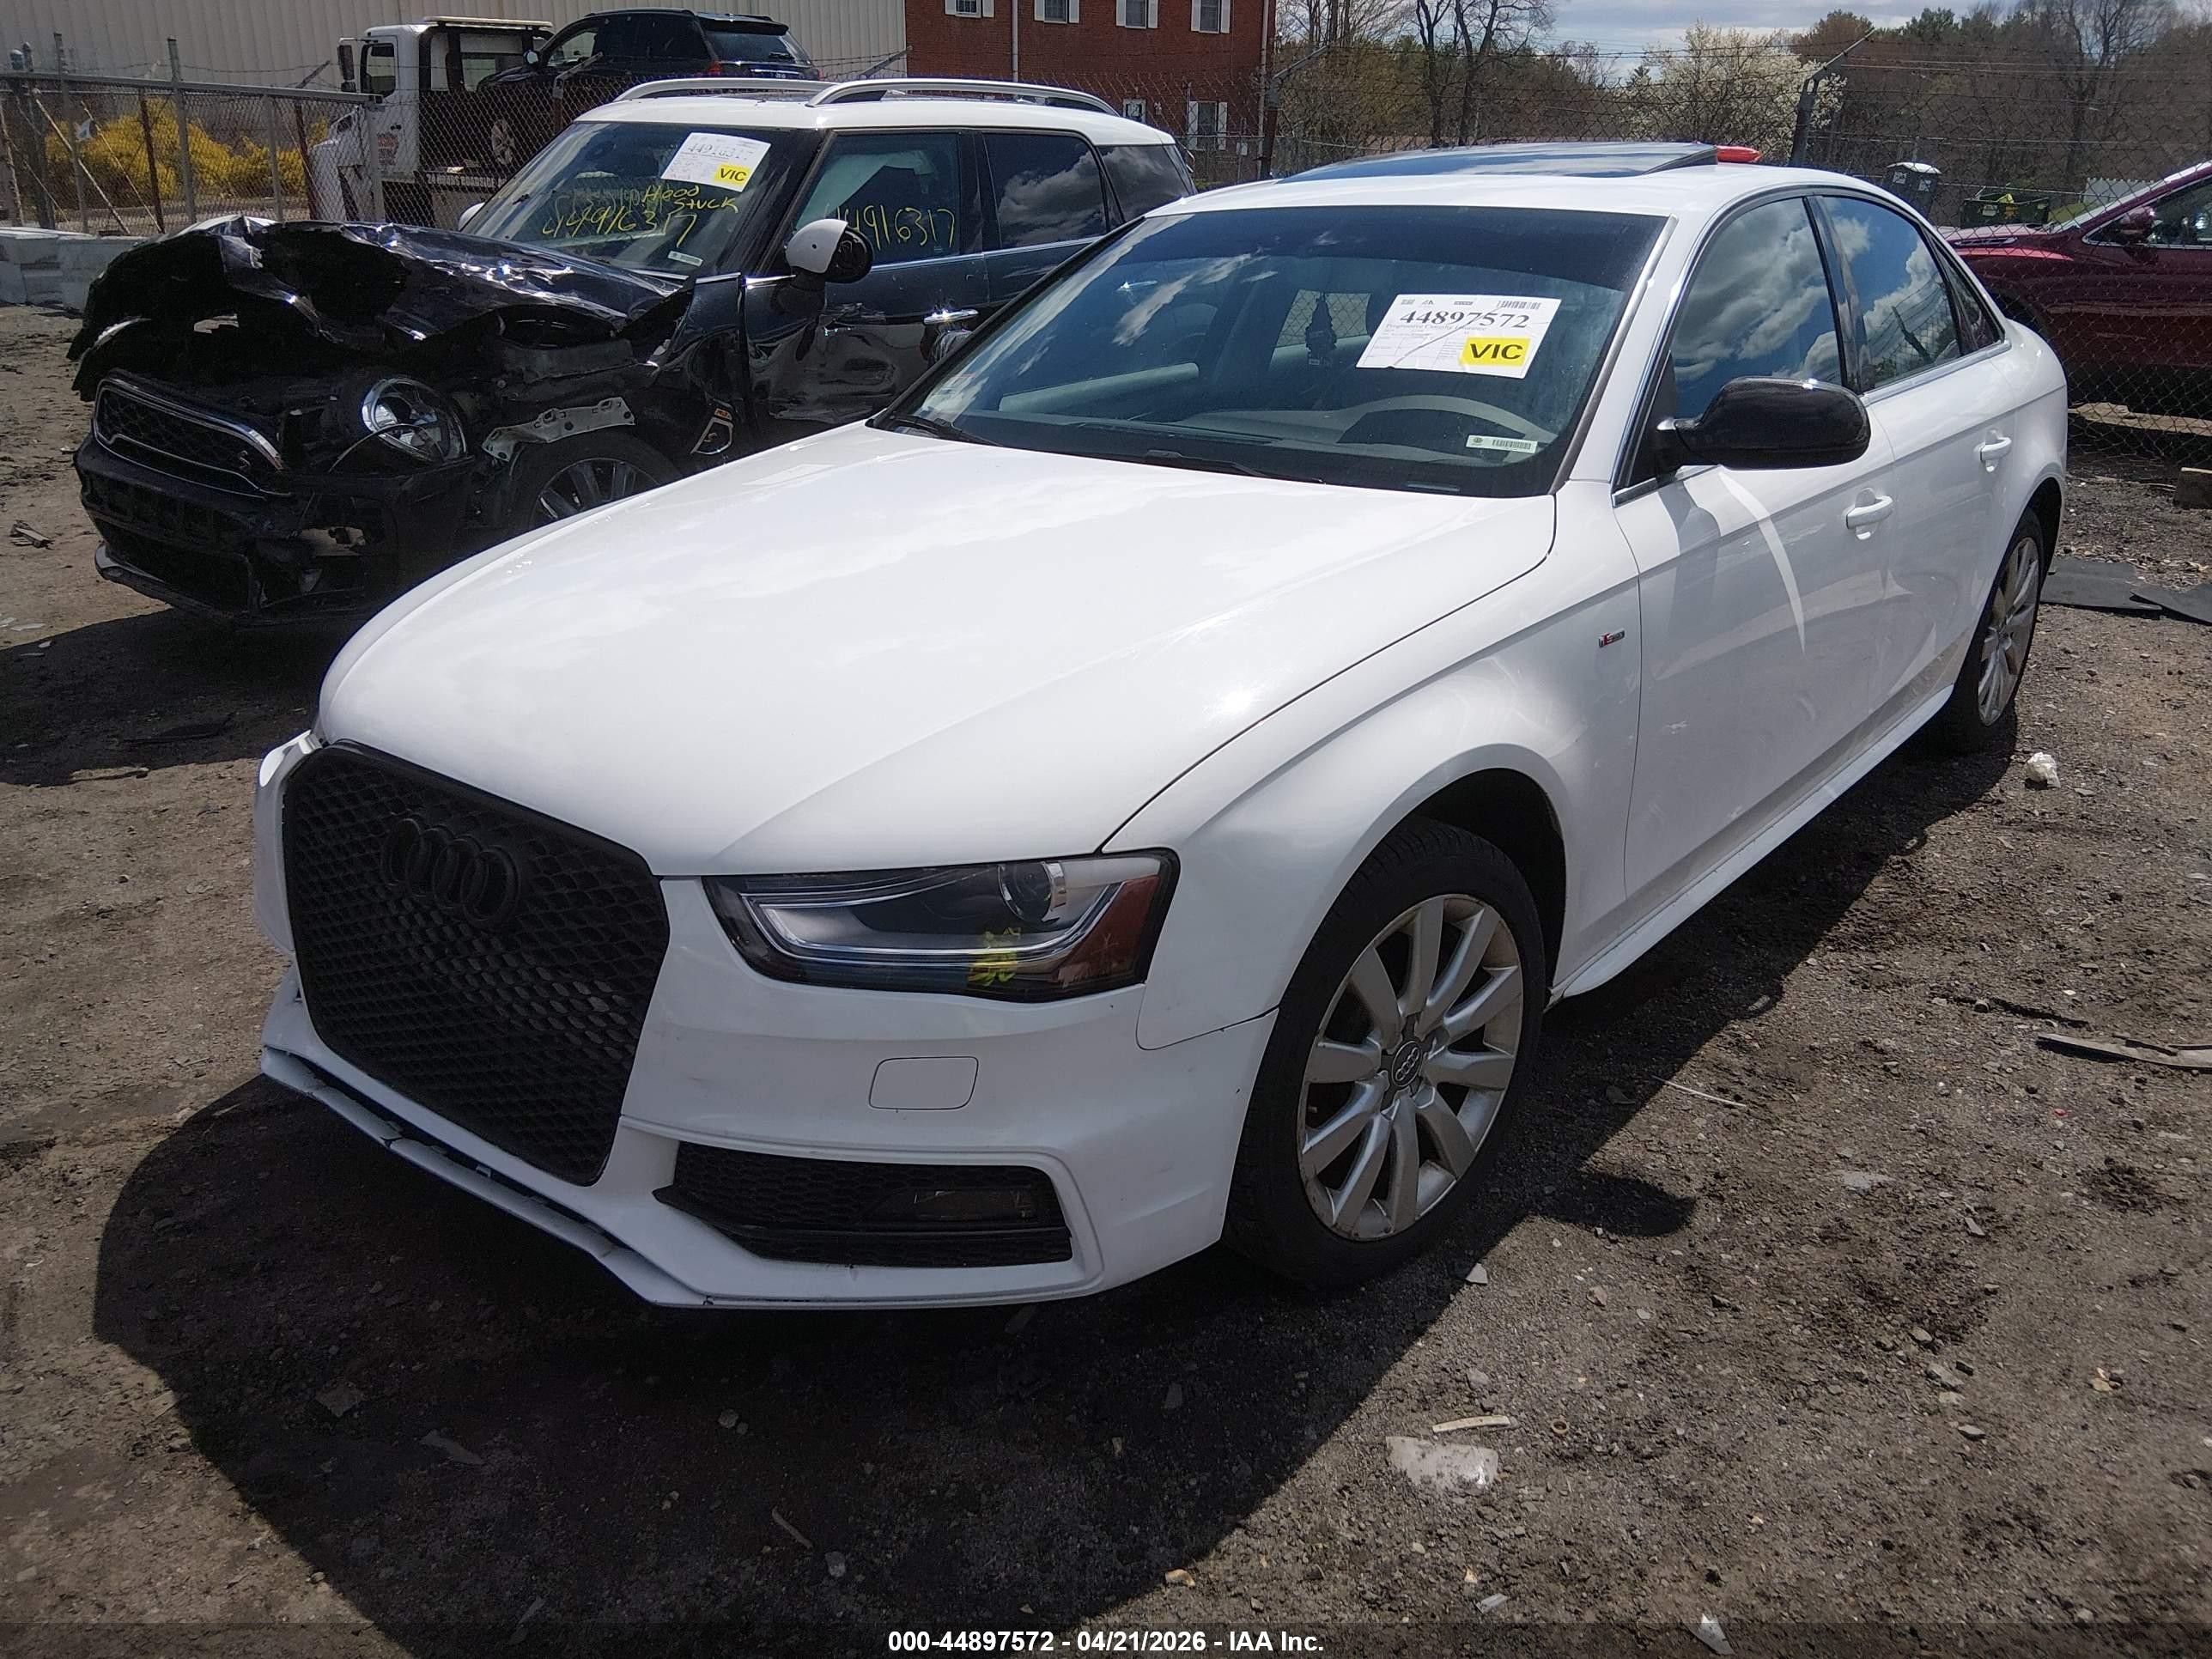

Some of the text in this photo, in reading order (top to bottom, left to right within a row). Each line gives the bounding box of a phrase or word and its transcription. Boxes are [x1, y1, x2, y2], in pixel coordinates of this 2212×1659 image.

[720, 167, 747, 182] VIC
[542, 205, 698, 248] 44916317
[1399, 310, 1530, 329] 44897572
[1469, 343, 1523, 360] VIC
